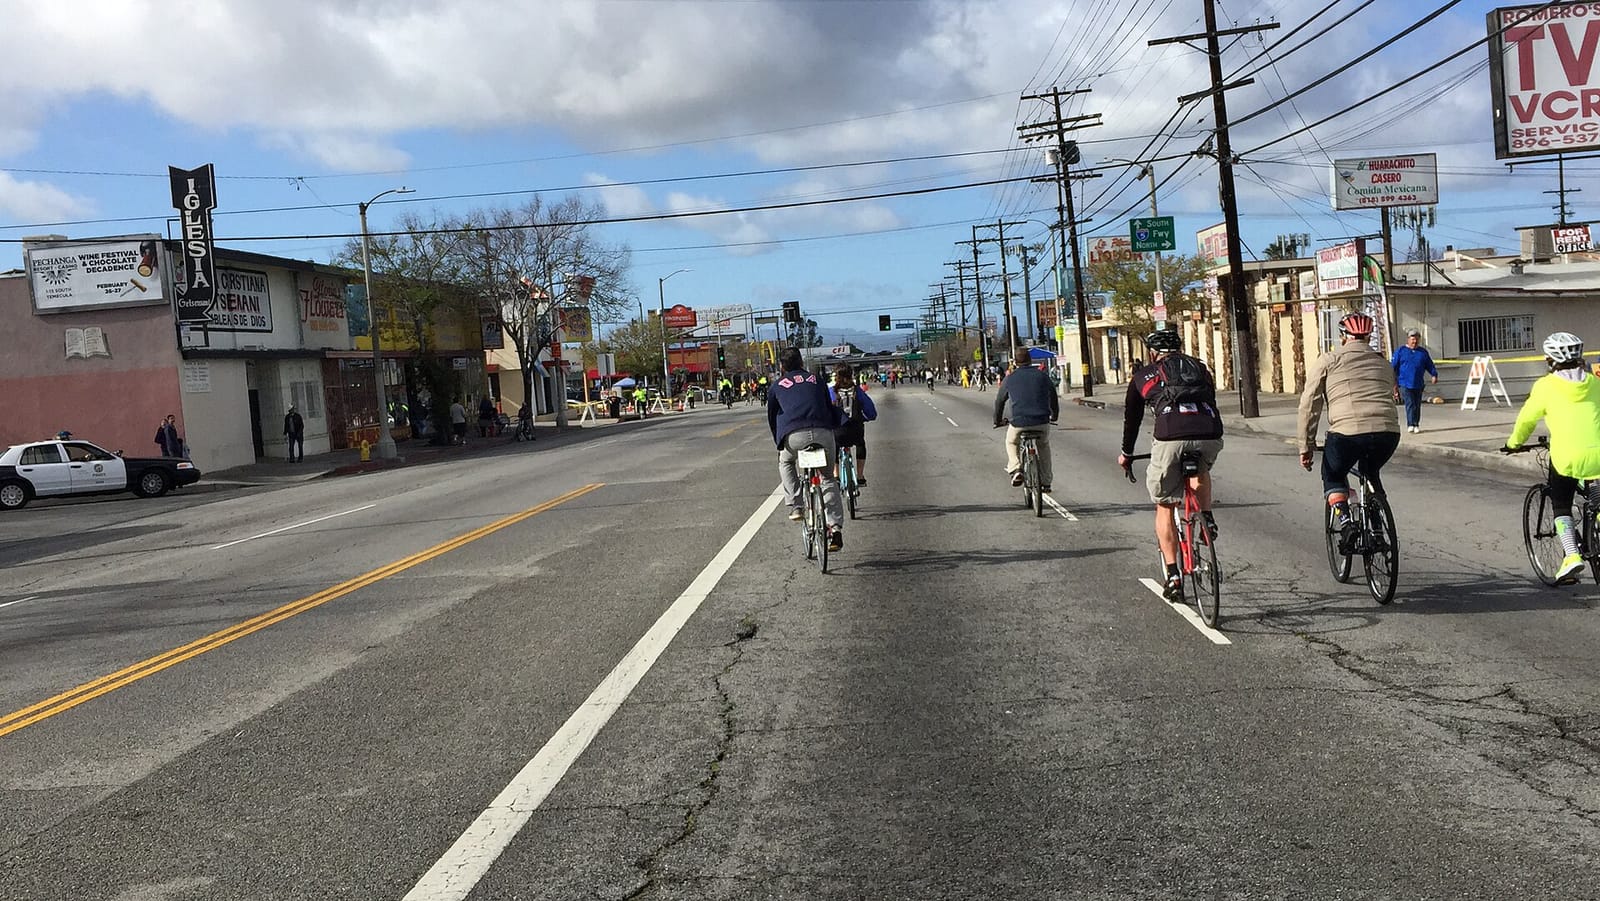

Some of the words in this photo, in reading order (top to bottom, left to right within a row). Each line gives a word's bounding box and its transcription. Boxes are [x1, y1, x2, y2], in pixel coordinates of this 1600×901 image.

[1505, 20, 1600, 91] TV
[1509, 89, 1600, 123] VCR
[1369, 159, 1415, 171] HUARACHITO
[1371, 173, 1402, 184] CASERO
[1347, 185, 1382, 195] Comida
[1385, 184, 1427, 194] Mexicana
[184, 178, 210, 289] IGLESIA
[1558, 228, 1584, 236] FOR
[1556, 234, 1588, 244] RENT
[32, 256, 77, 266] PECHANGA
[78, 252, 100, 261] WINE
[101, 250, 139, 259] FESTIVAL
[88, 257, 137, 266] CHOCOLATE
[86, 264, 135, 274] DECADENCE
